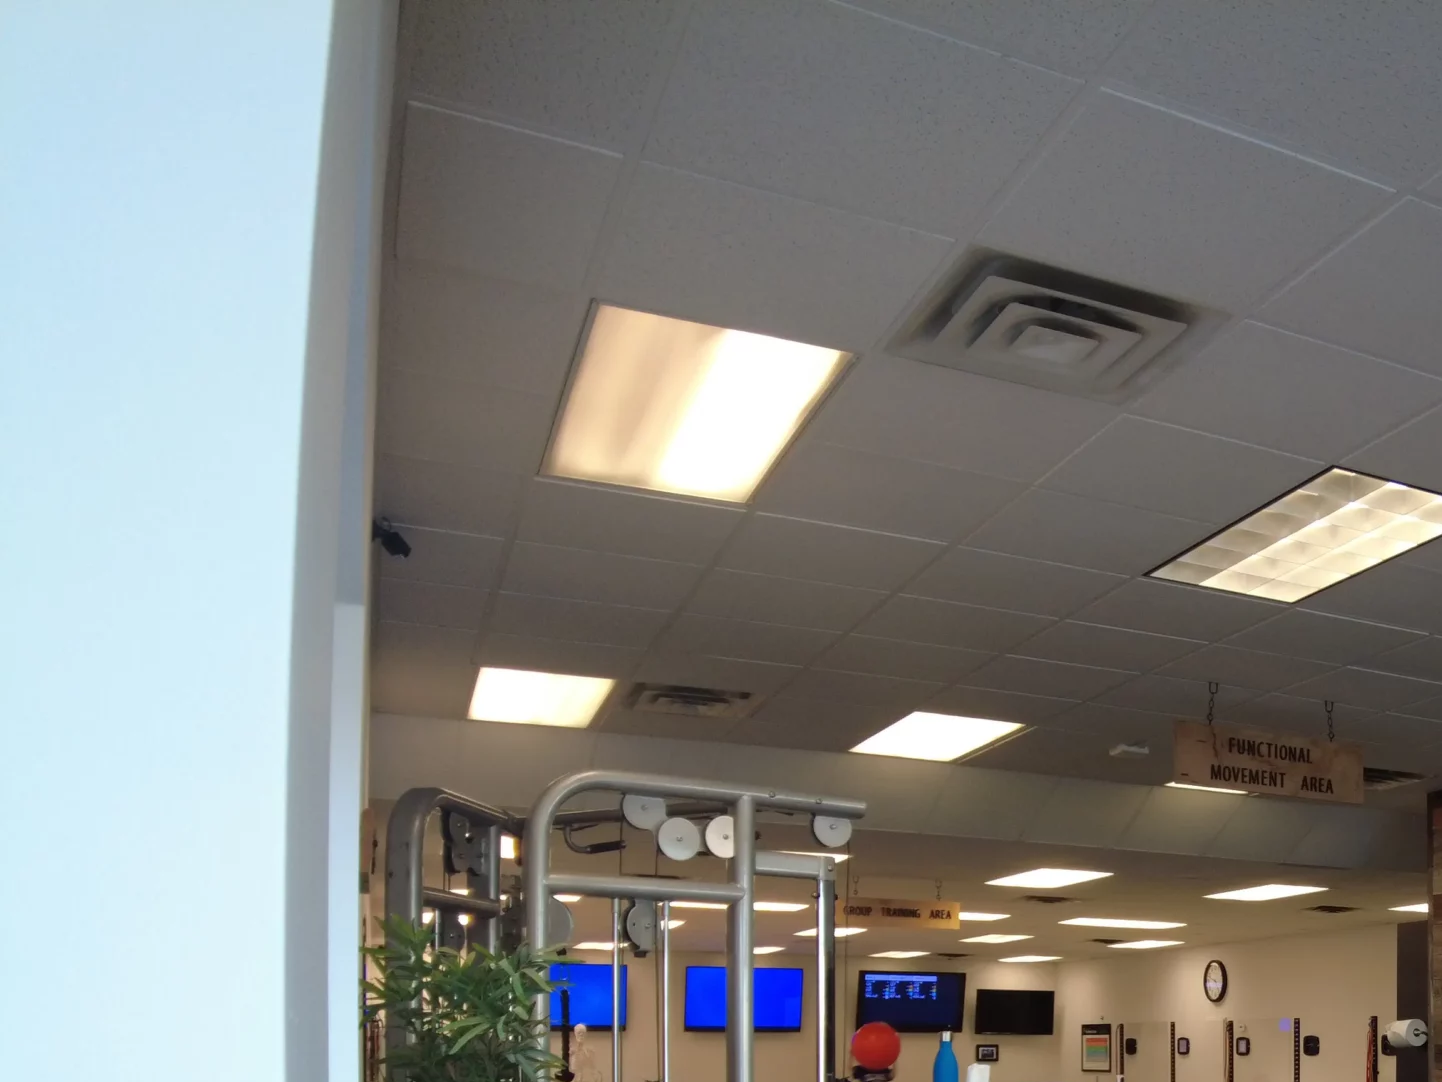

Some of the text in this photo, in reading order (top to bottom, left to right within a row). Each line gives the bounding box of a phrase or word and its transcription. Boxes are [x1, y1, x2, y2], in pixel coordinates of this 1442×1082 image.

[1228, 737, 1313, 764] FUNCTIONAL
[1210, 764, 1333, 794] MOVEMENT AREA
[843, 905, 952, 920] GROUP TRAINING AREA
